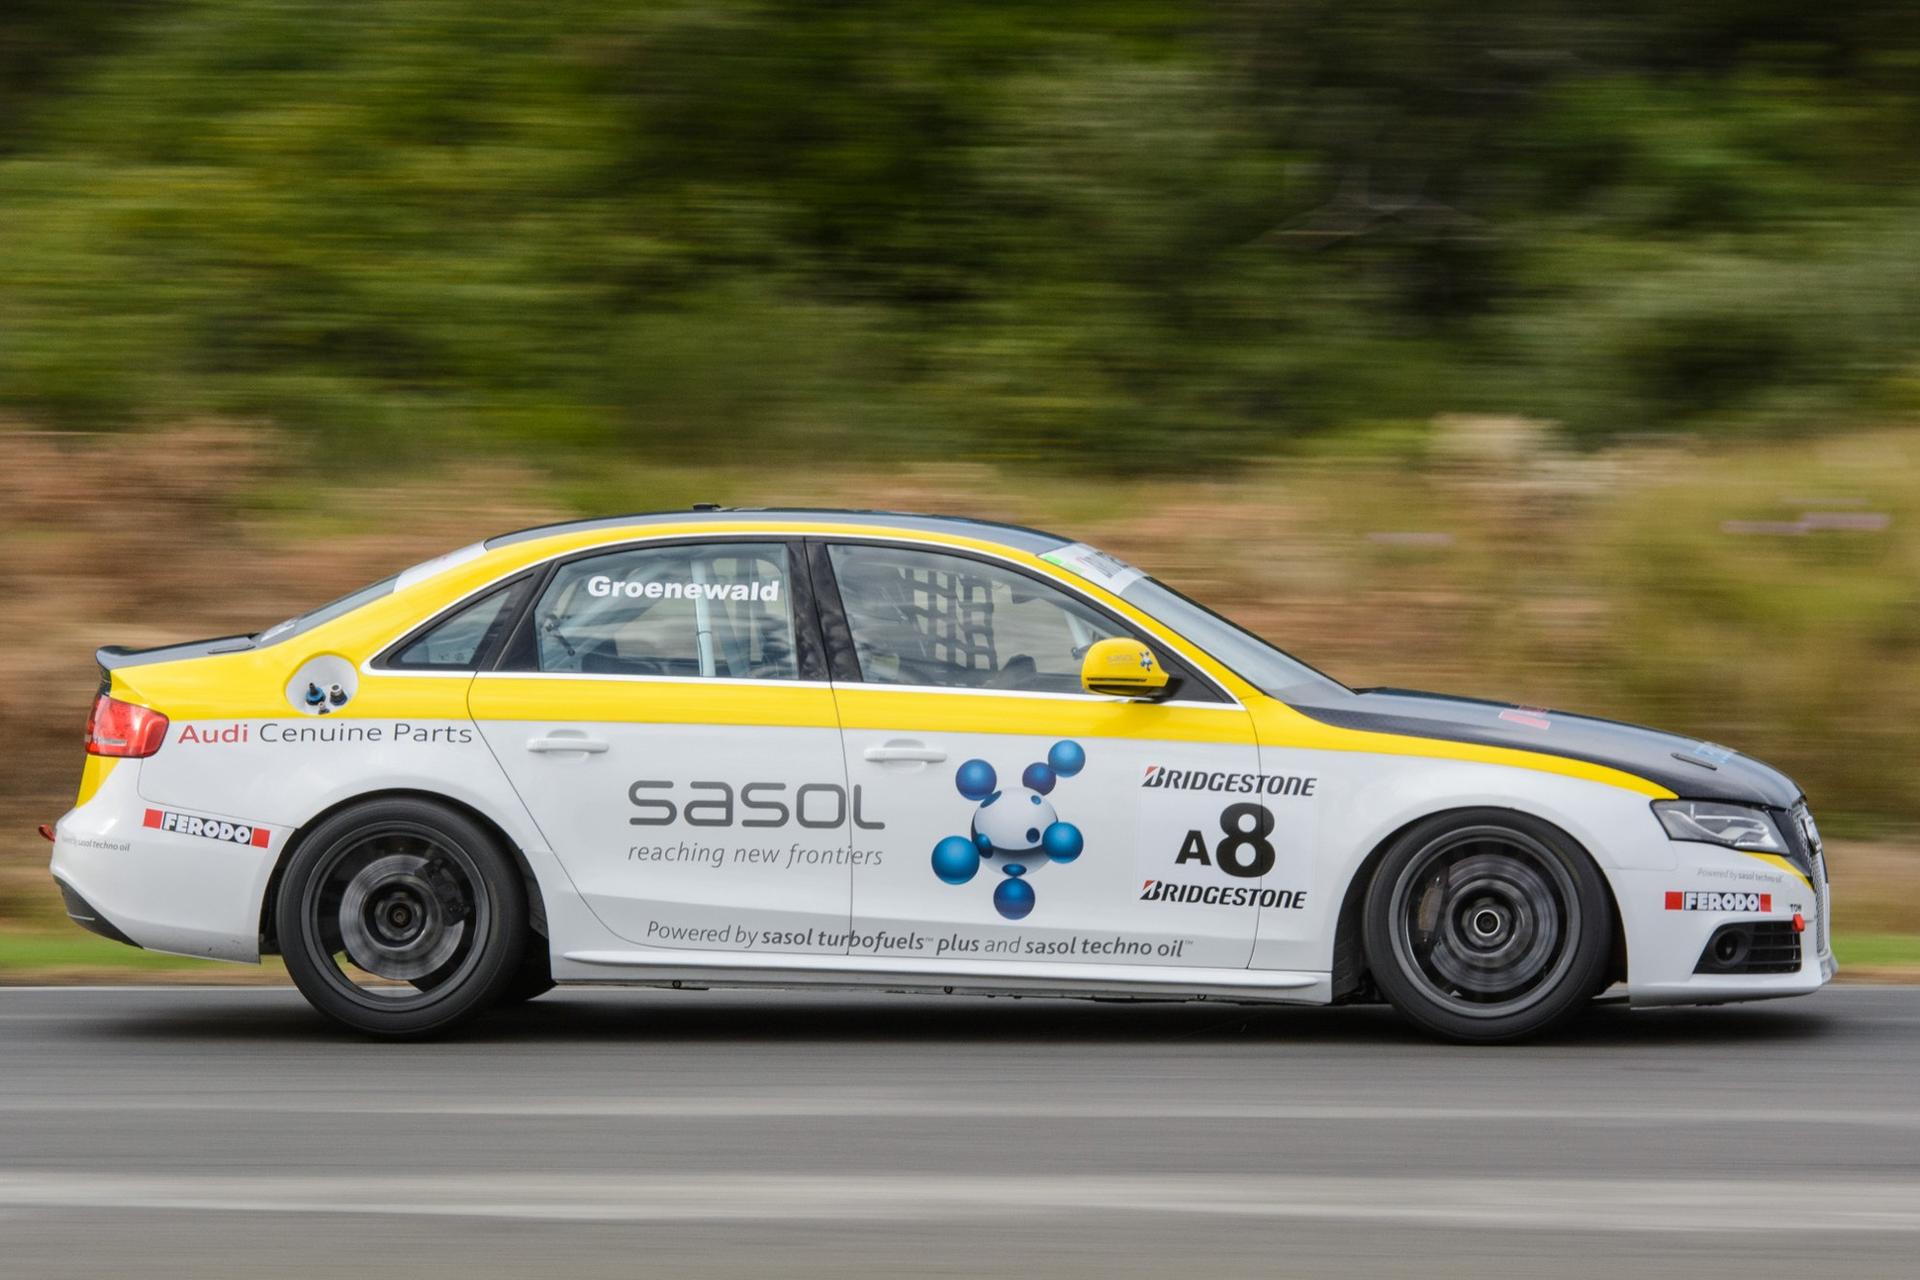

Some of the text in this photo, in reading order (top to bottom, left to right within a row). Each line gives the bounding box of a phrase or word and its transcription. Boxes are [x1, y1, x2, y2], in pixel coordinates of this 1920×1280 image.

[587, 575, 780, 602] Groenewald
[177, 724, 249, 744] Audi
[393, 723, 473, 743] Parts
[1142, 765, 1317, 797] BRIDGESTONE
[162, 812, 251, 844] FERODO
[628, 841, 884, 869] reaching new frontiers
[1140, 879, 1308, 910] BRIDGESTONE
[1684, 892, 1760, 911] FERODO
[647, 920, 732, 943] Powered
[734, 925, 759, 949] by
[761, 928, 813, 946] sasol
[935, 933, 980, 956] plus
[984, 936, 1022, 954] and
[1024, 936, 1077, 955] sasol
[1081, 937, 1153, 956] techno
